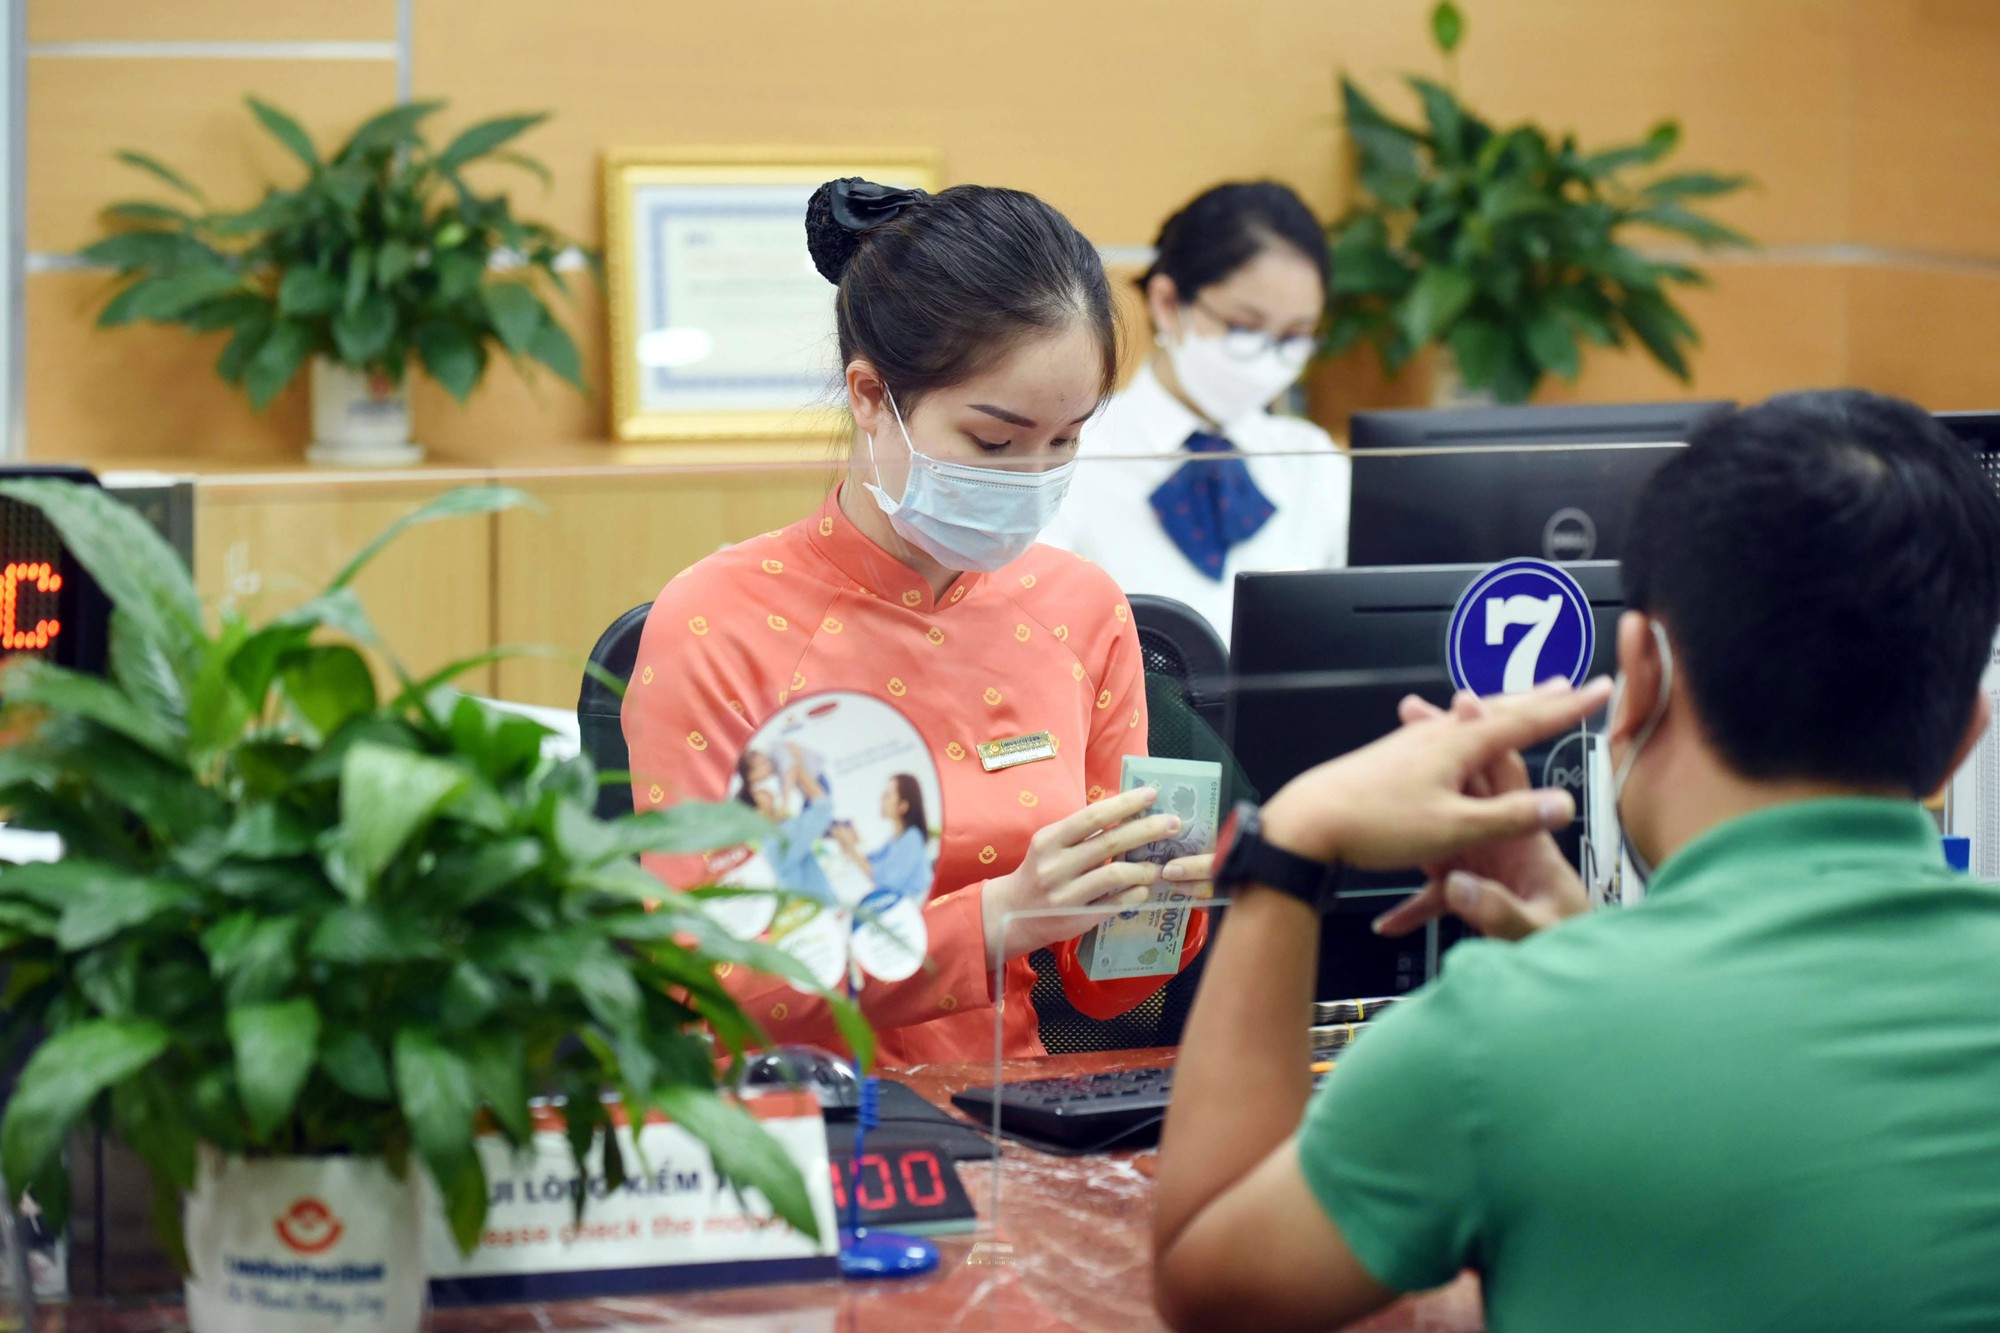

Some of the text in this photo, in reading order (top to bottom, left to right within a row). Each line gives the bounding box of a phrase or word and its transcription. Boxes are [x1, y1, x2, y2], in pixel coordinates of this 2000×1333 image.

[0, 562, 62, 649] C
[1485, 593, 1564, 695] 7
[481, 1226, 550, 1247] ease
